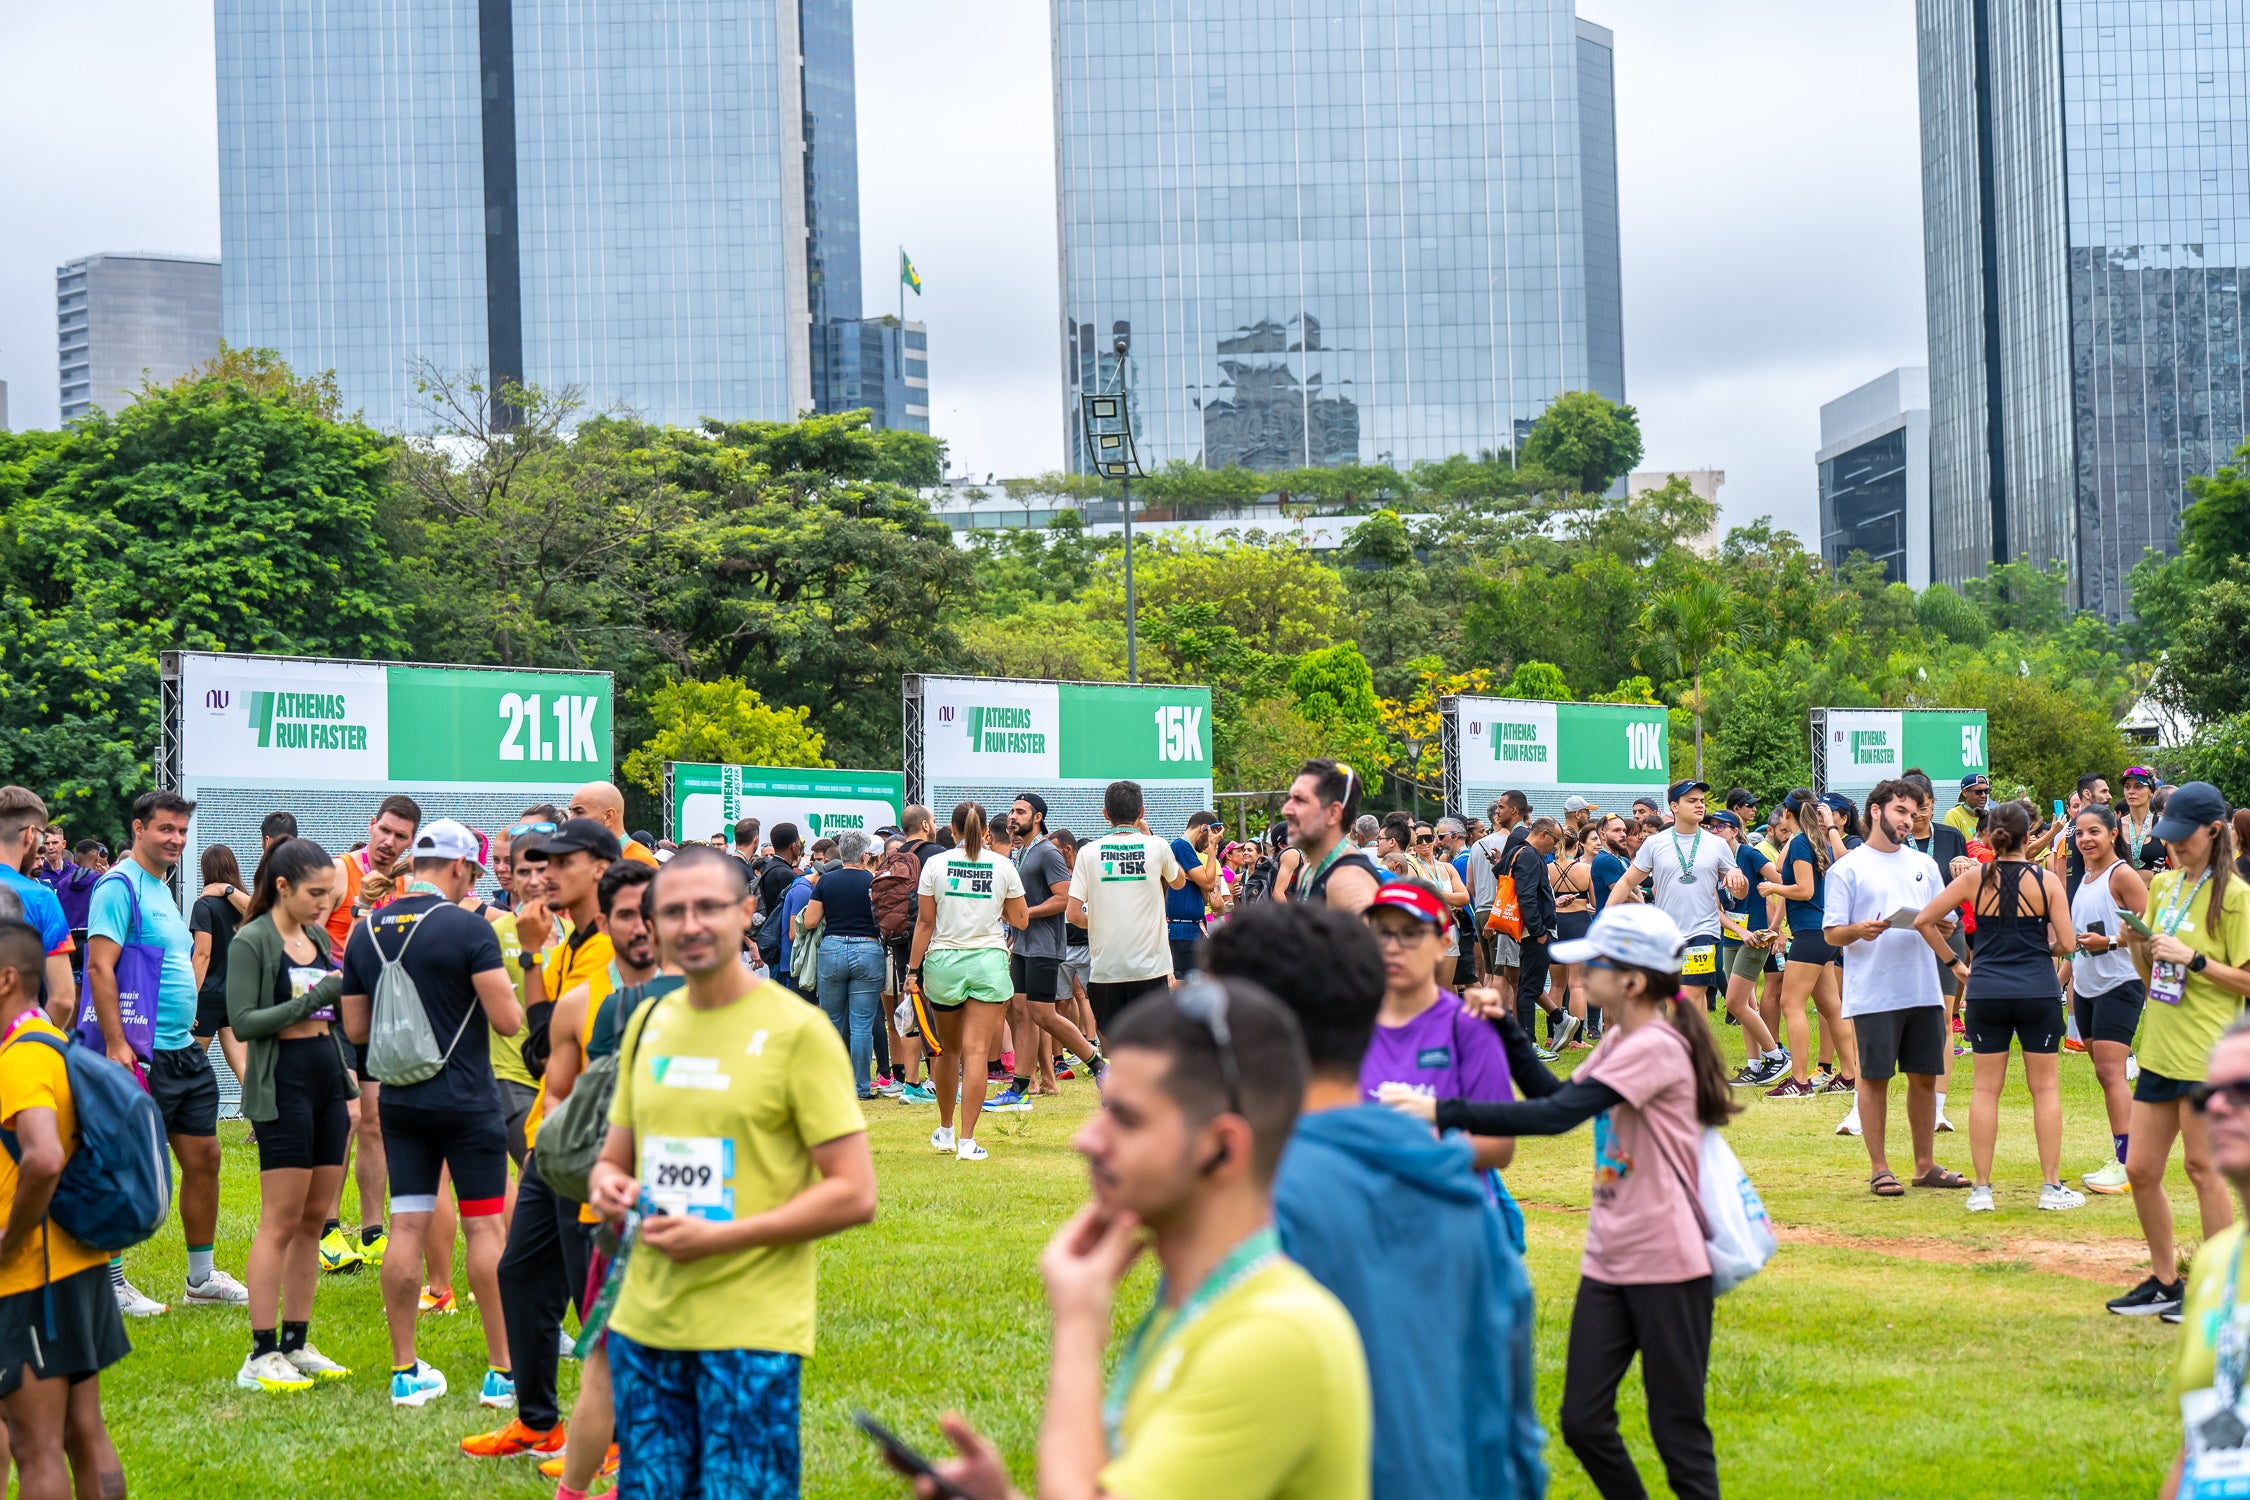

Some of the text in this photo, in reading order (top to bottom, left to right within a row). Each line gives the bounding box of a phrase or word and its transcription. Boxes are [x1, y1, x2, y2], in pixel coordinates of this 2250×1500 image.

[276, 692, 345, 719] ATHENAS
[499, 692, 598, 762] 21.1K
[985, 707, 1031, 729] ATHENAS
[276, 723, 367, 750] RUN FASTER
[1155, 705, 1204, 762] 15K
[1503, 722, 1537, 742] ATHENAS
[1860, 731, 1886, 746] ATHENAS
[985, 732, 1045, 754] RUN FASTER
[1626, 722, 1663, 770] 10K
[1961, 725, 1983, 767] 5K
[1503, 744, 1547, 763] RUN FASTER
[1860, 748, 1895, 764] RUN FASTER
[724, 767, 733, 820] ATHENAS
[824, 814, 864, 829] ATHENAS
[1101, 851, 1145, 861] FINISHER
[947, 868, 993, 879] FINISHER
[1119, 861, 1146, 874] 15K
[972, 880, 992, 892] 5K
[1694, 954, 1708, 963] 519
[120, 991, 139, 999] mais
[122, 1015, 149, 1024] orrida
[657, 1163, 711, 1187] 2909
